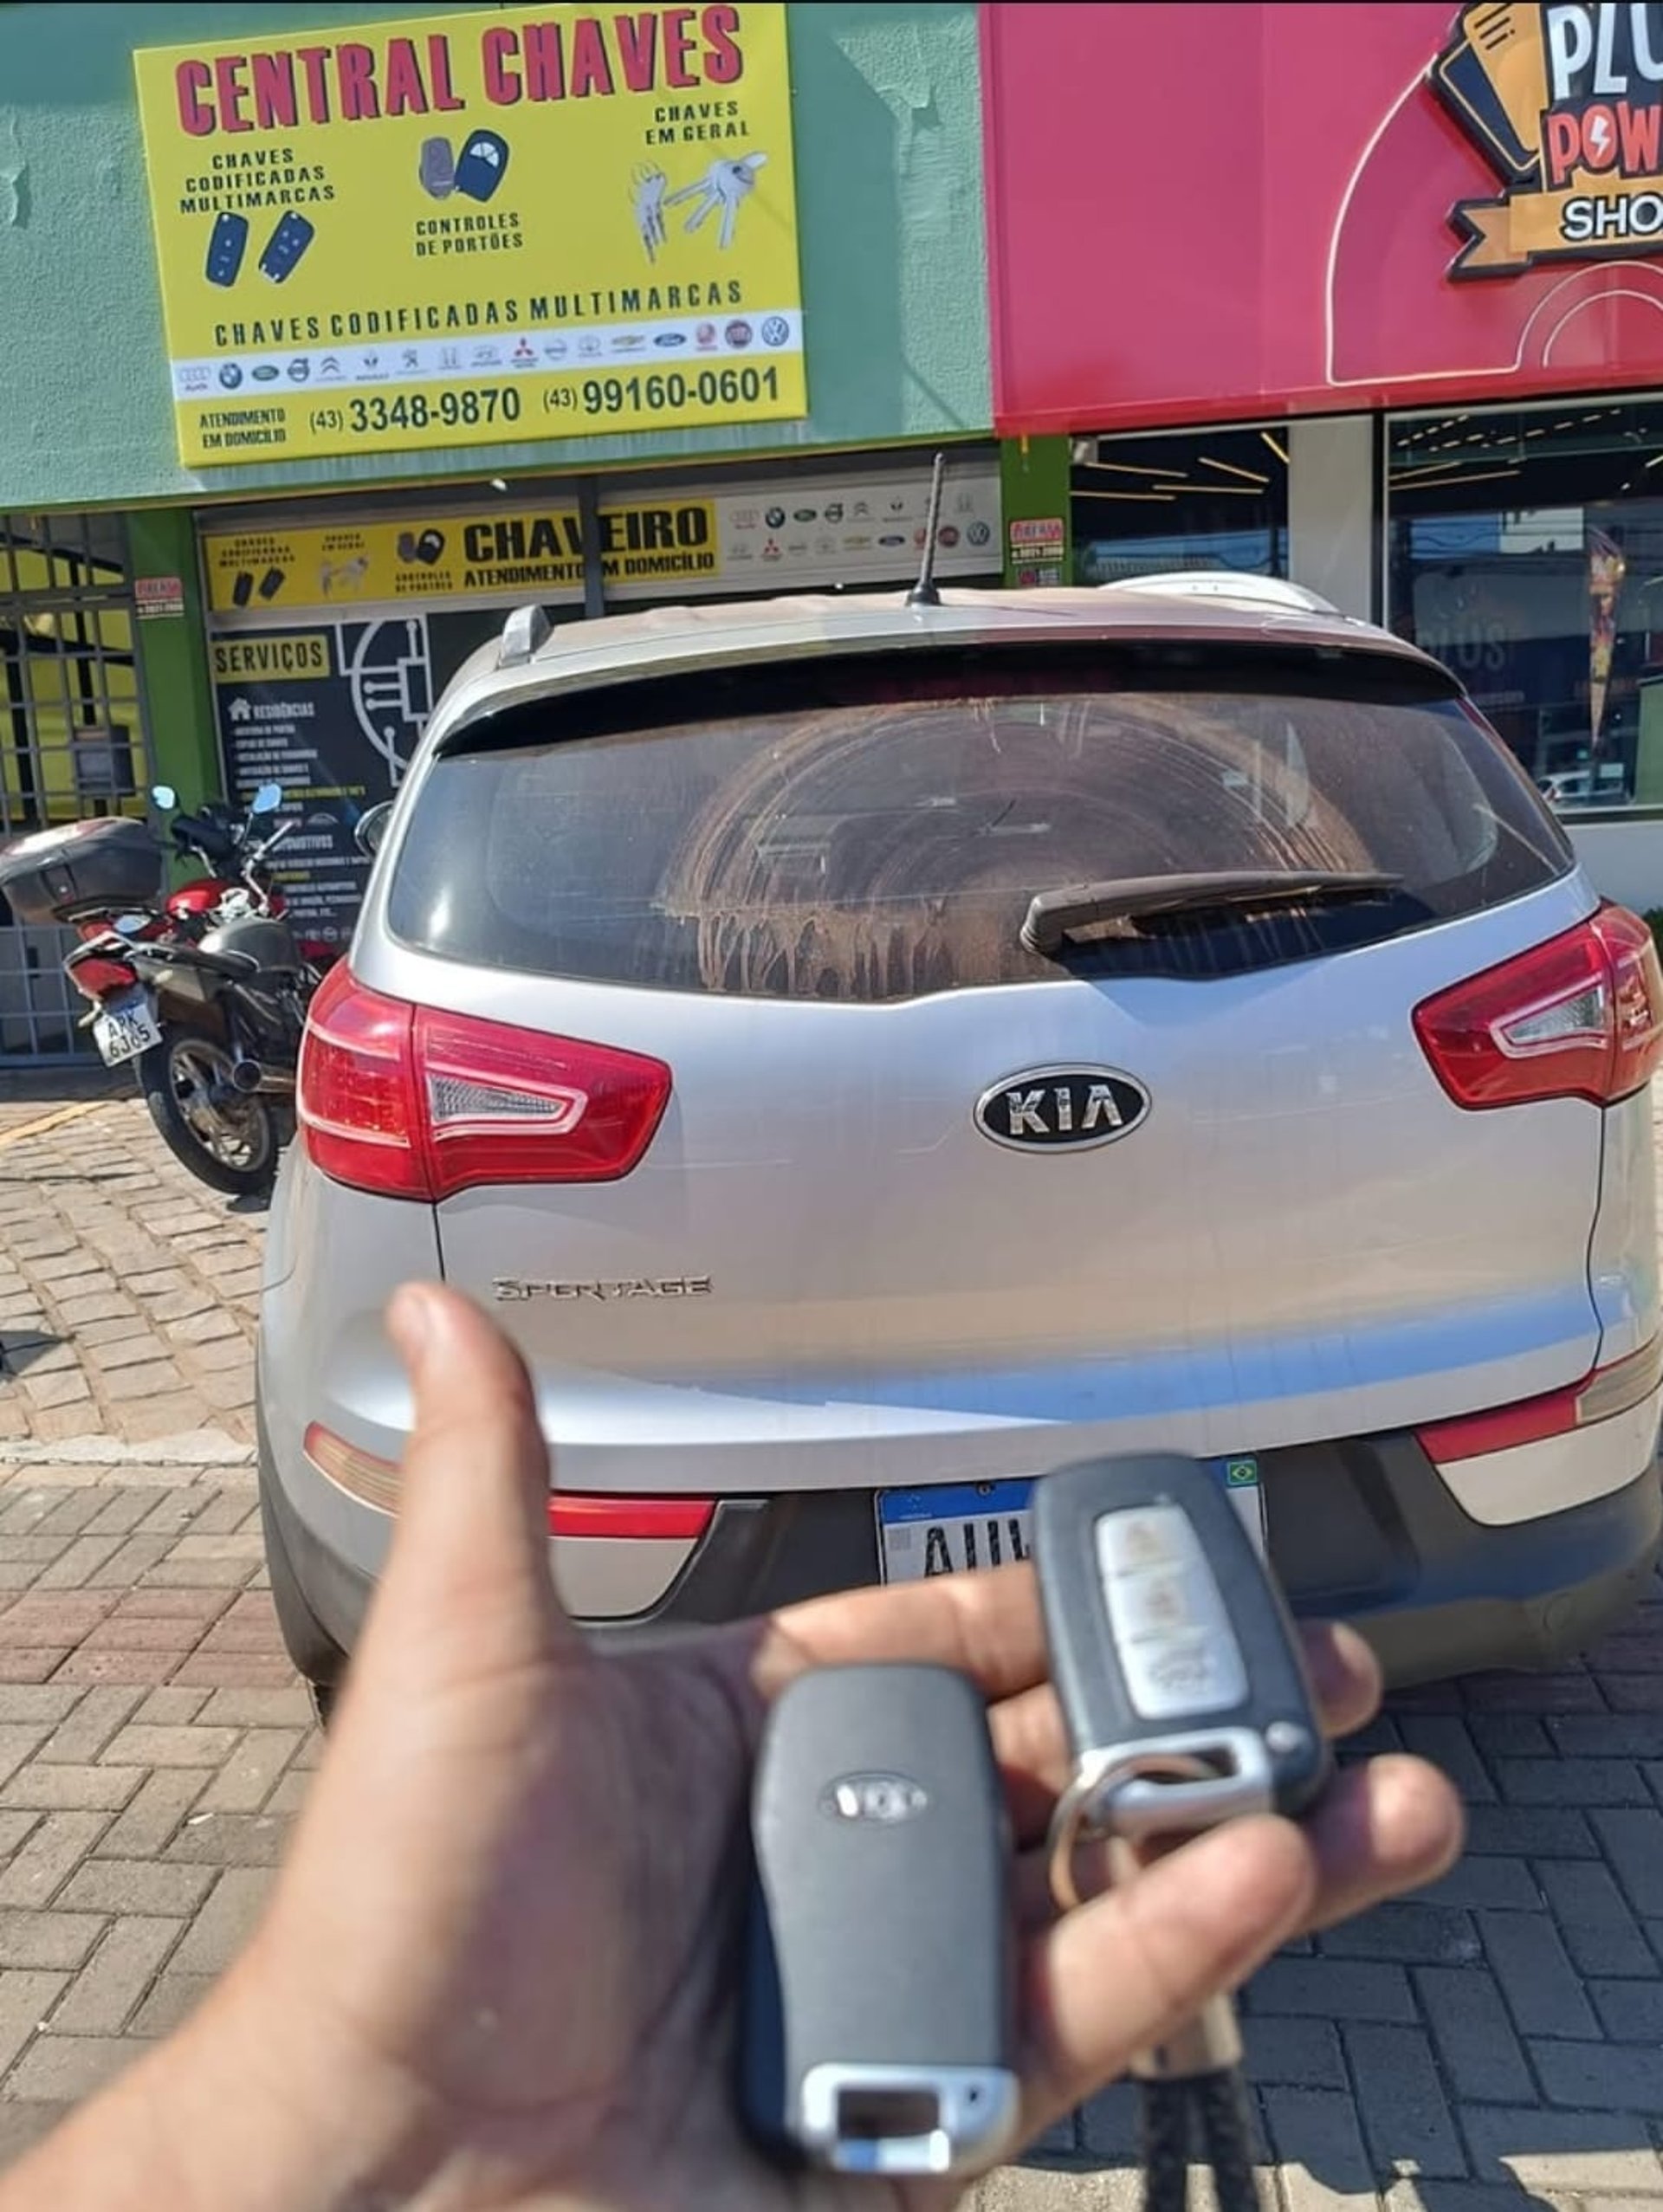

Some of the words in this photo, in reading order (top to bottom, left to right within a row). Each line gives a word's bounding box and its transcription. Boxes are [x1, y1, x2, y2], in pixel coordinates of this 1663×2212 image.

[175, 35, 464, 136] CENTRAL
[482, 4, 741, 106] CHAVES
[655, 100, 738, 123] CHAVES
[645, 127, 674, 145] EM
[683, 120, 749, 141] GERAL
[212, 148, 294, 170] CHAVES
[185, 165, 325, 192] CODIFICADAS
[179, 185, 335, 213] MULTIMARCAS
[416, 212, 519, 236] CONTROLES
[416, 240, 437, 256] DE
[443, 232, 523, 254] PORTÕES
[215, 316, 320, 347] CHAVES
[331, 300, 518, 337] CODIFICADAS
[530, 280, 743, 320] MULTIMARCAS
[542, 388, 579, 414] (43)
[583, 365, 778, 415] 99160-0601
[199, 408, 286, 429] ATENDIMENTO
[309, 410, 344, 432] (43)
[349, 387, 521, 432] 3348-9870
[203, 434, 222, 449] EM
[625, 552, 715, 574] DOMICÍLIO
[215, 641, 322, 673] SERVIÇOS
[1006, 1084, 1123, 1135] KIA
[491, 1275, 714, 1300] SPORTAGE
